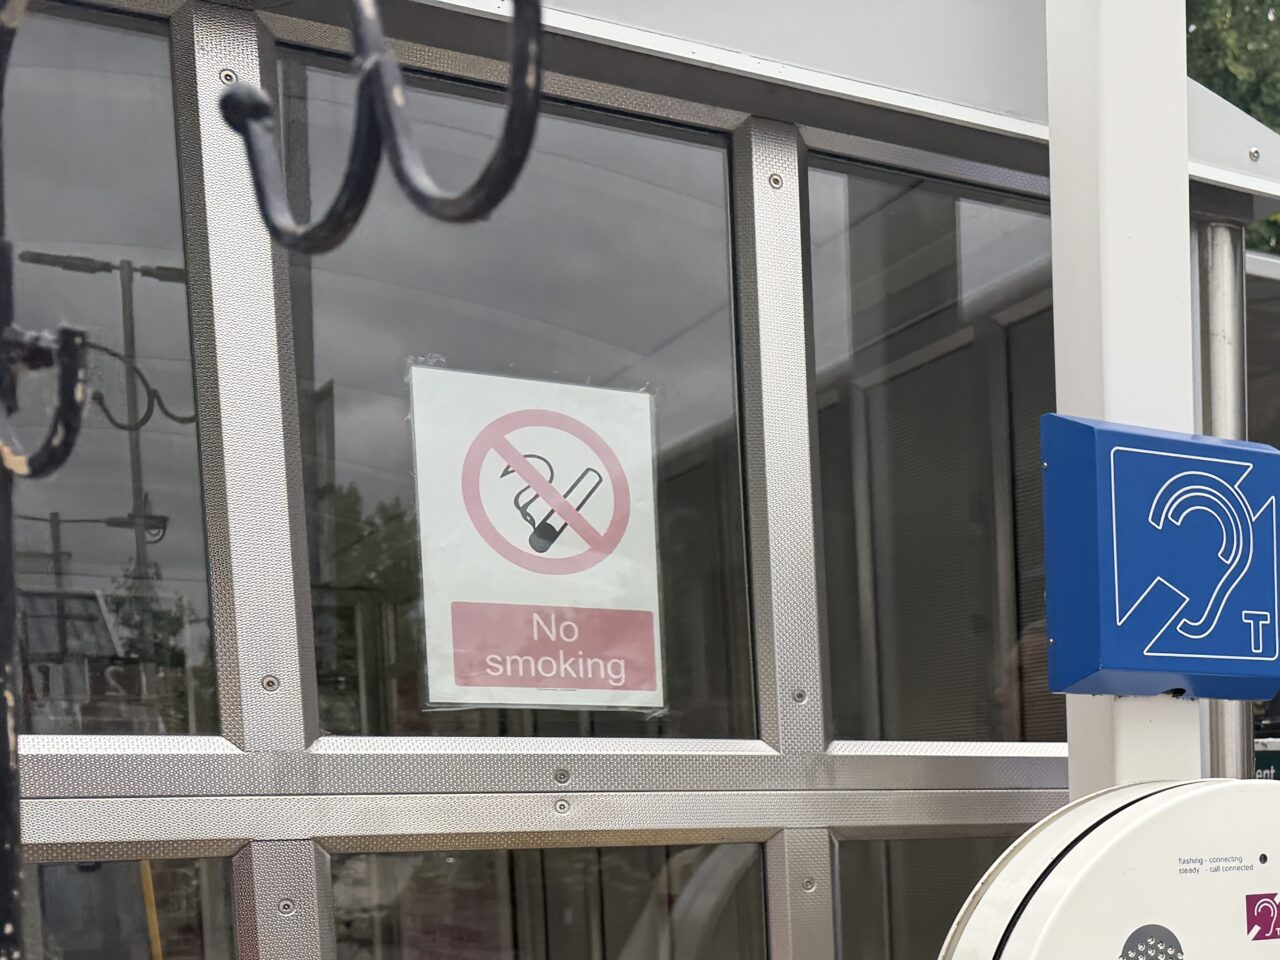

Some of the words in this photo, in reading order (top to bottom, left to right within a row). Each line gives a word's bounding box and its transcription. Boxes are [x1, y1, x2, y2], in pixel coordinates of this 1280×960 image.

[532, 612, 579, 642] No
[1242, 610, 1270, 653] T
[486, 650, 626, 686] smoking
[1179, 857, 1203, 865] flashing
[1222, 864, 1253, 872] connected
